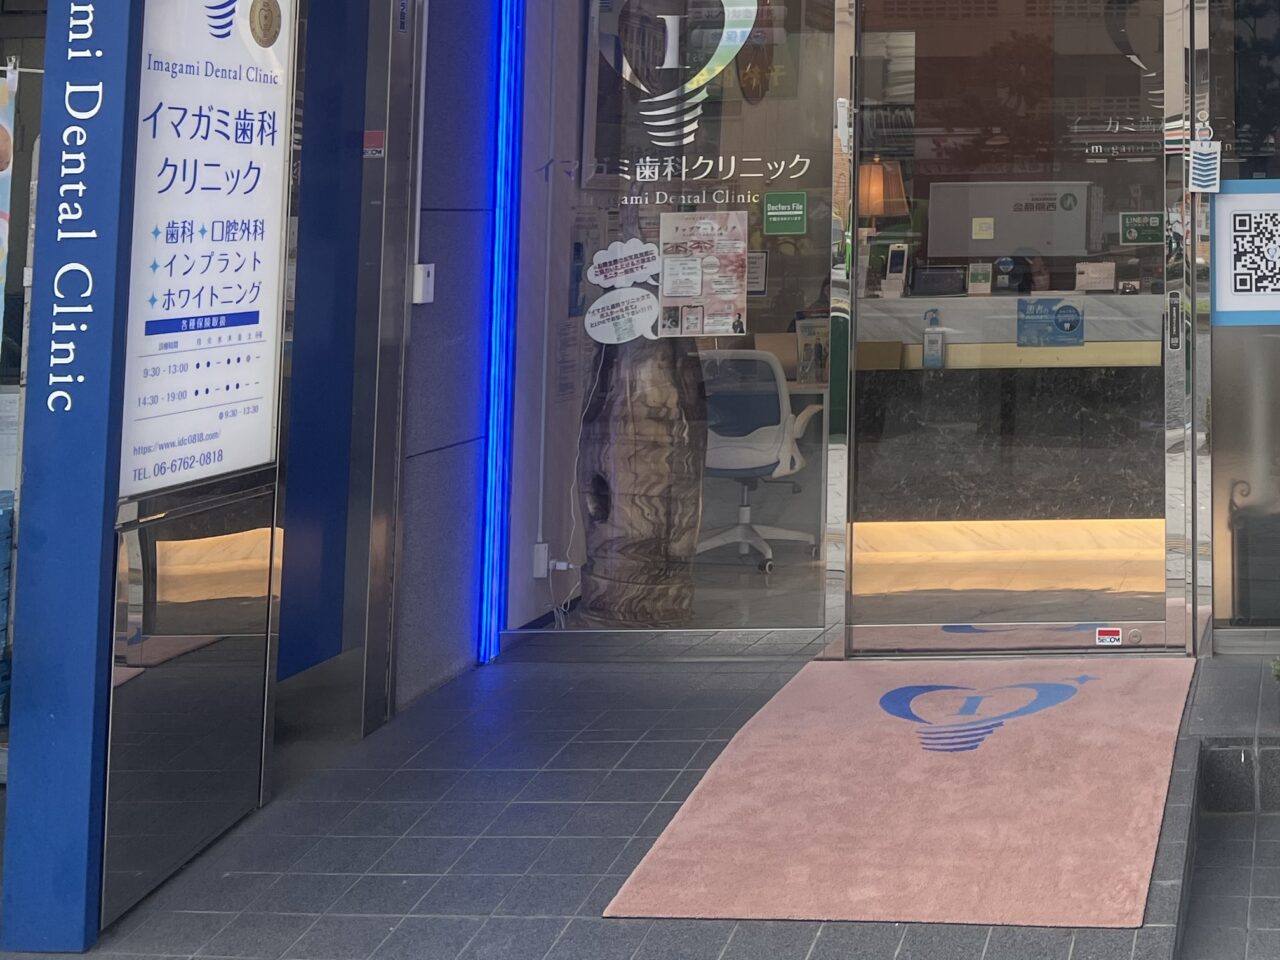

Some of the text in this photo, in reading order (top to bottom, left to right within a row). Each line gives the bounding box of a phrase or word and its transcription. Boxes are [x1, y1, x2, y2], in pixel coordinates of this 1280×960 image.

[147, 53, 279, 85] Imagami Dental Clinic
[142, 101, 278, 147] イマガミ歯科
[56, 81, 103, 242] Dental
[157, 157, 261, 196] クリニック
[712, 189, 761, 205] Clinic
[767, 202, 804, 211] Doctors File
[165, 219, 195, 244] 歯科
[211, 218, 265, 242] 口腔外科
[164, 251, 261, 278] インプラント
[162, 280, 262, 311] ホワイトニング
[46, 261, 94, 413] Clinic
[143, 366, 161, 378] 9:30
[168, 363, 189, 375] 13:00
[137, 394, 159, 407] 14:30
[167, 390, 188, 403] 19:00
[132, 430, 222, 457] https://www.idc0818.com/
[132, 448, 224, 482] TEL. 06-6762-0818
